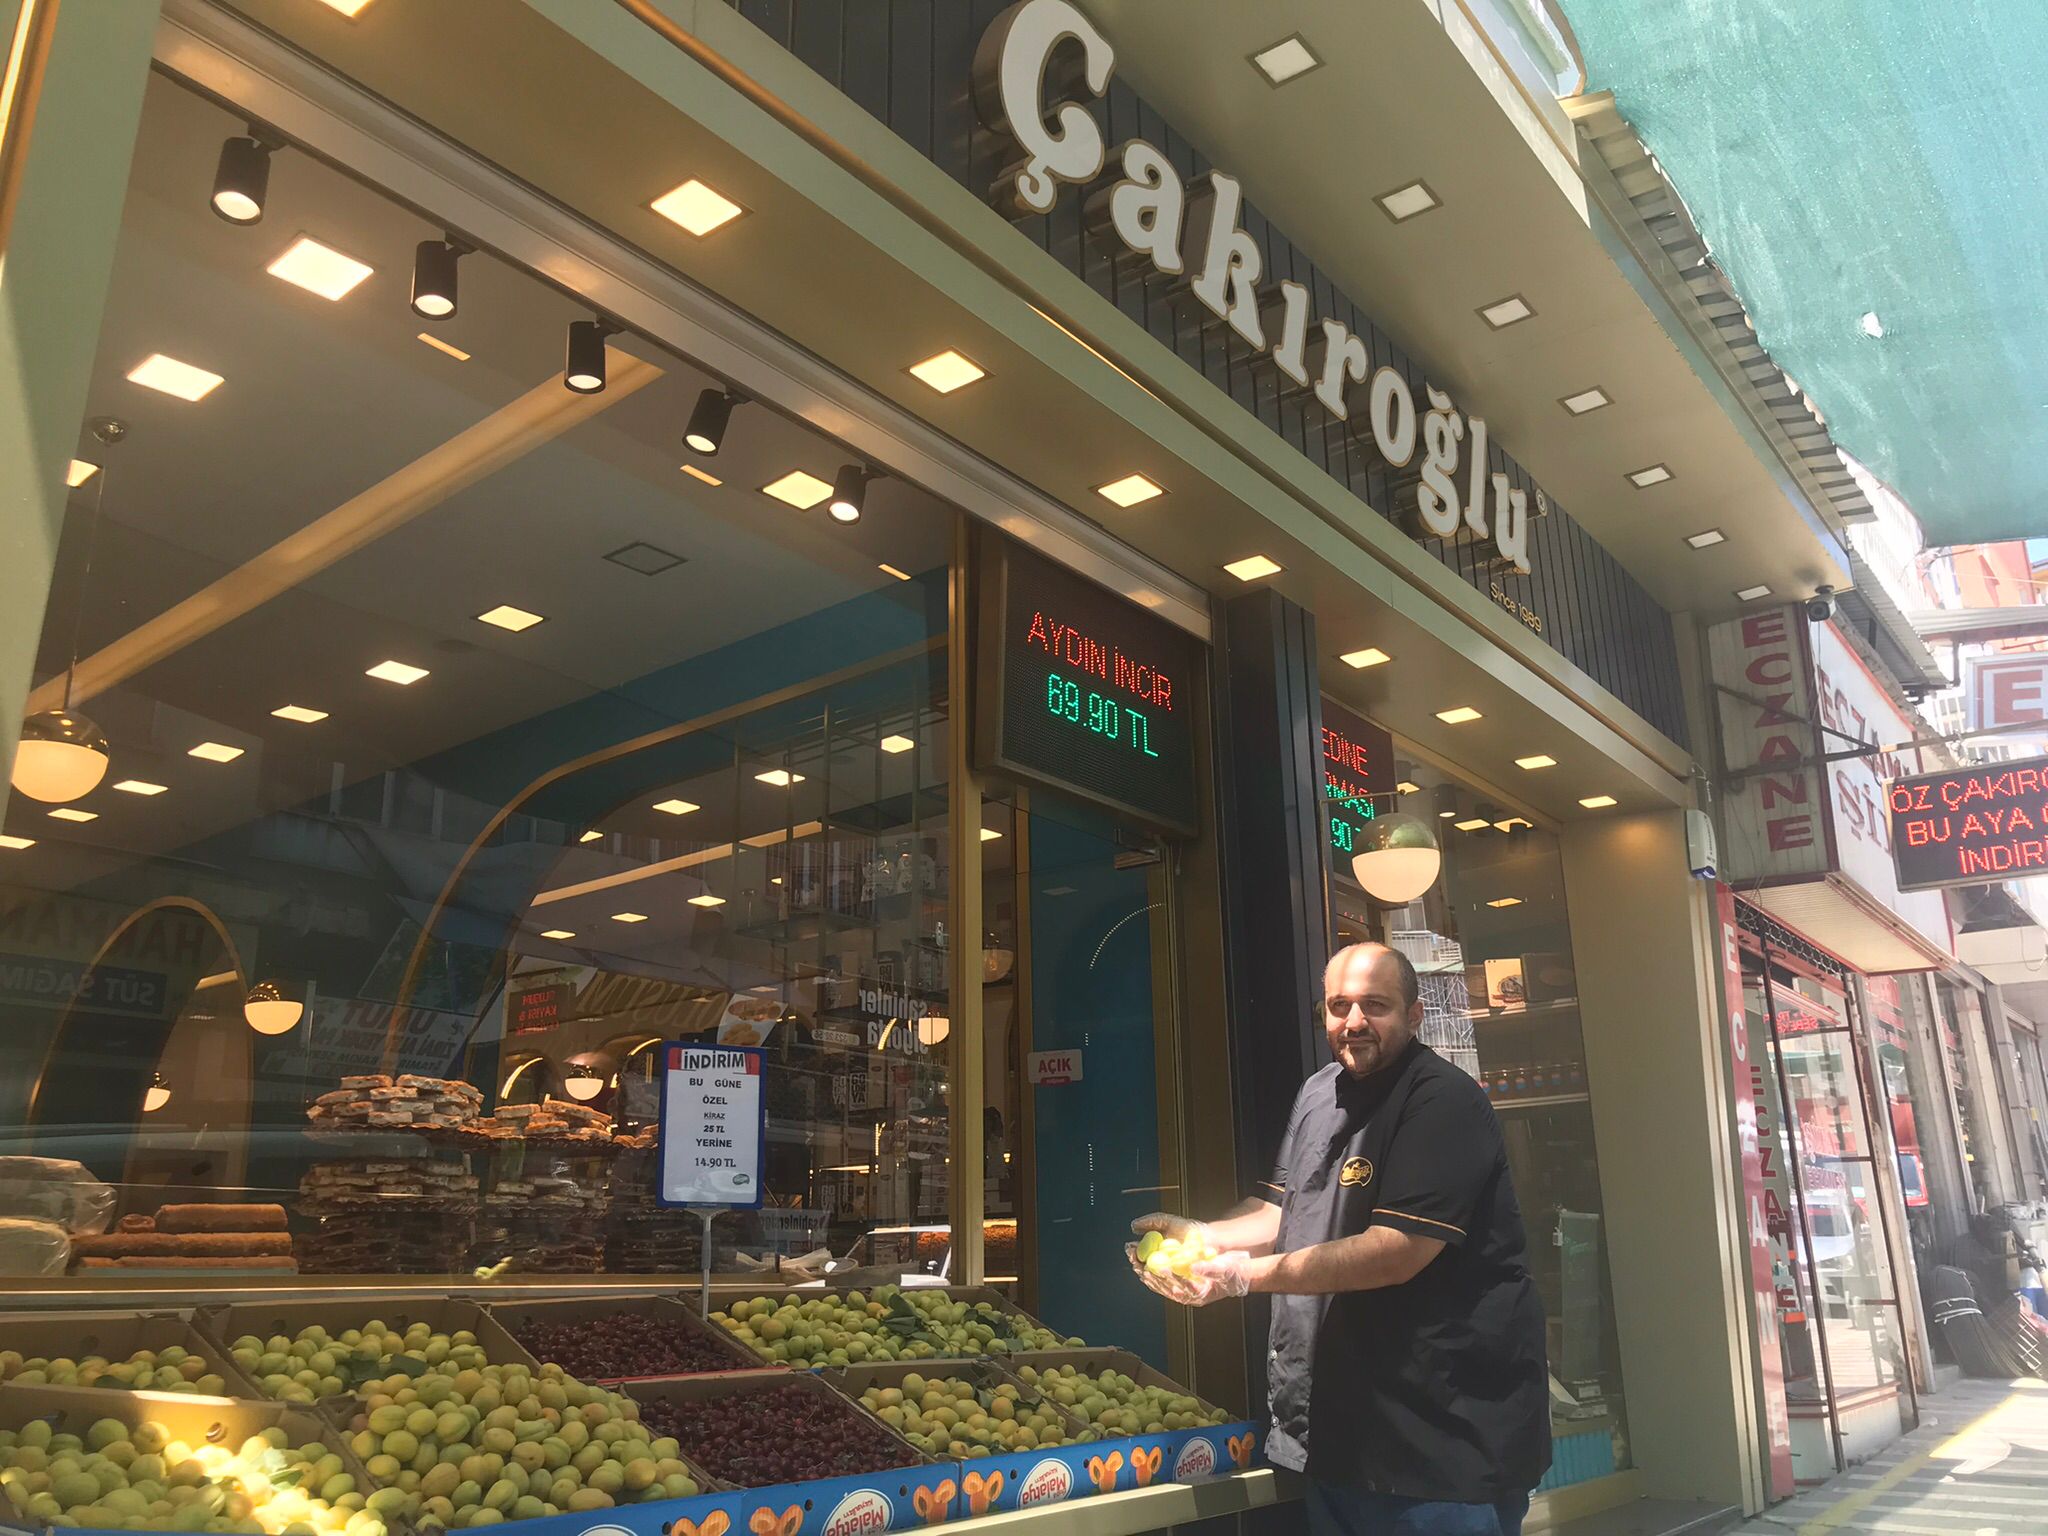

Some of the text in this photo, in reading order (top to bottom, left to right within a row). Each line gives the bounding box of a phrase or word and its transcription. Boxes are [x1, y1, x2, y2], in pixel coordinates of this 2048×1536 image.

[1000, 0, 1532, 575] Çakıroğlu
[1490, 582, 1516, 613] Since
[1028, 612, 1172, 711] AYDIN İNCİR
[1049, 674, 1159, 757] 69.90 TL
[1742, 612, 1814, 852] ECZANE
[1890, 785, 1934, 813] ÖZ
[1907, 817, 1951, 847] BU
[1961, 807, 2034, 838] AYA
[683, 1050, 745, 1071] İNDİRİM
[1038, 1057, 1072, 1074] AÇIK
[689, 1077, 742, 1088] BU GÜNE
[702, 1095, 728, 1105] ÖZEL
[703, 1111, 726, 1120] KİRAZ
[703, 1125, 726, 1133] 25 TL
[695, 1137, 733, 1148] YERİNE
[694, 1157, 737, 1168] 14.90 TL
[1021, 1473, 1067, 1506] Malatya
[827, 1504, 885, 1536] Malatya
